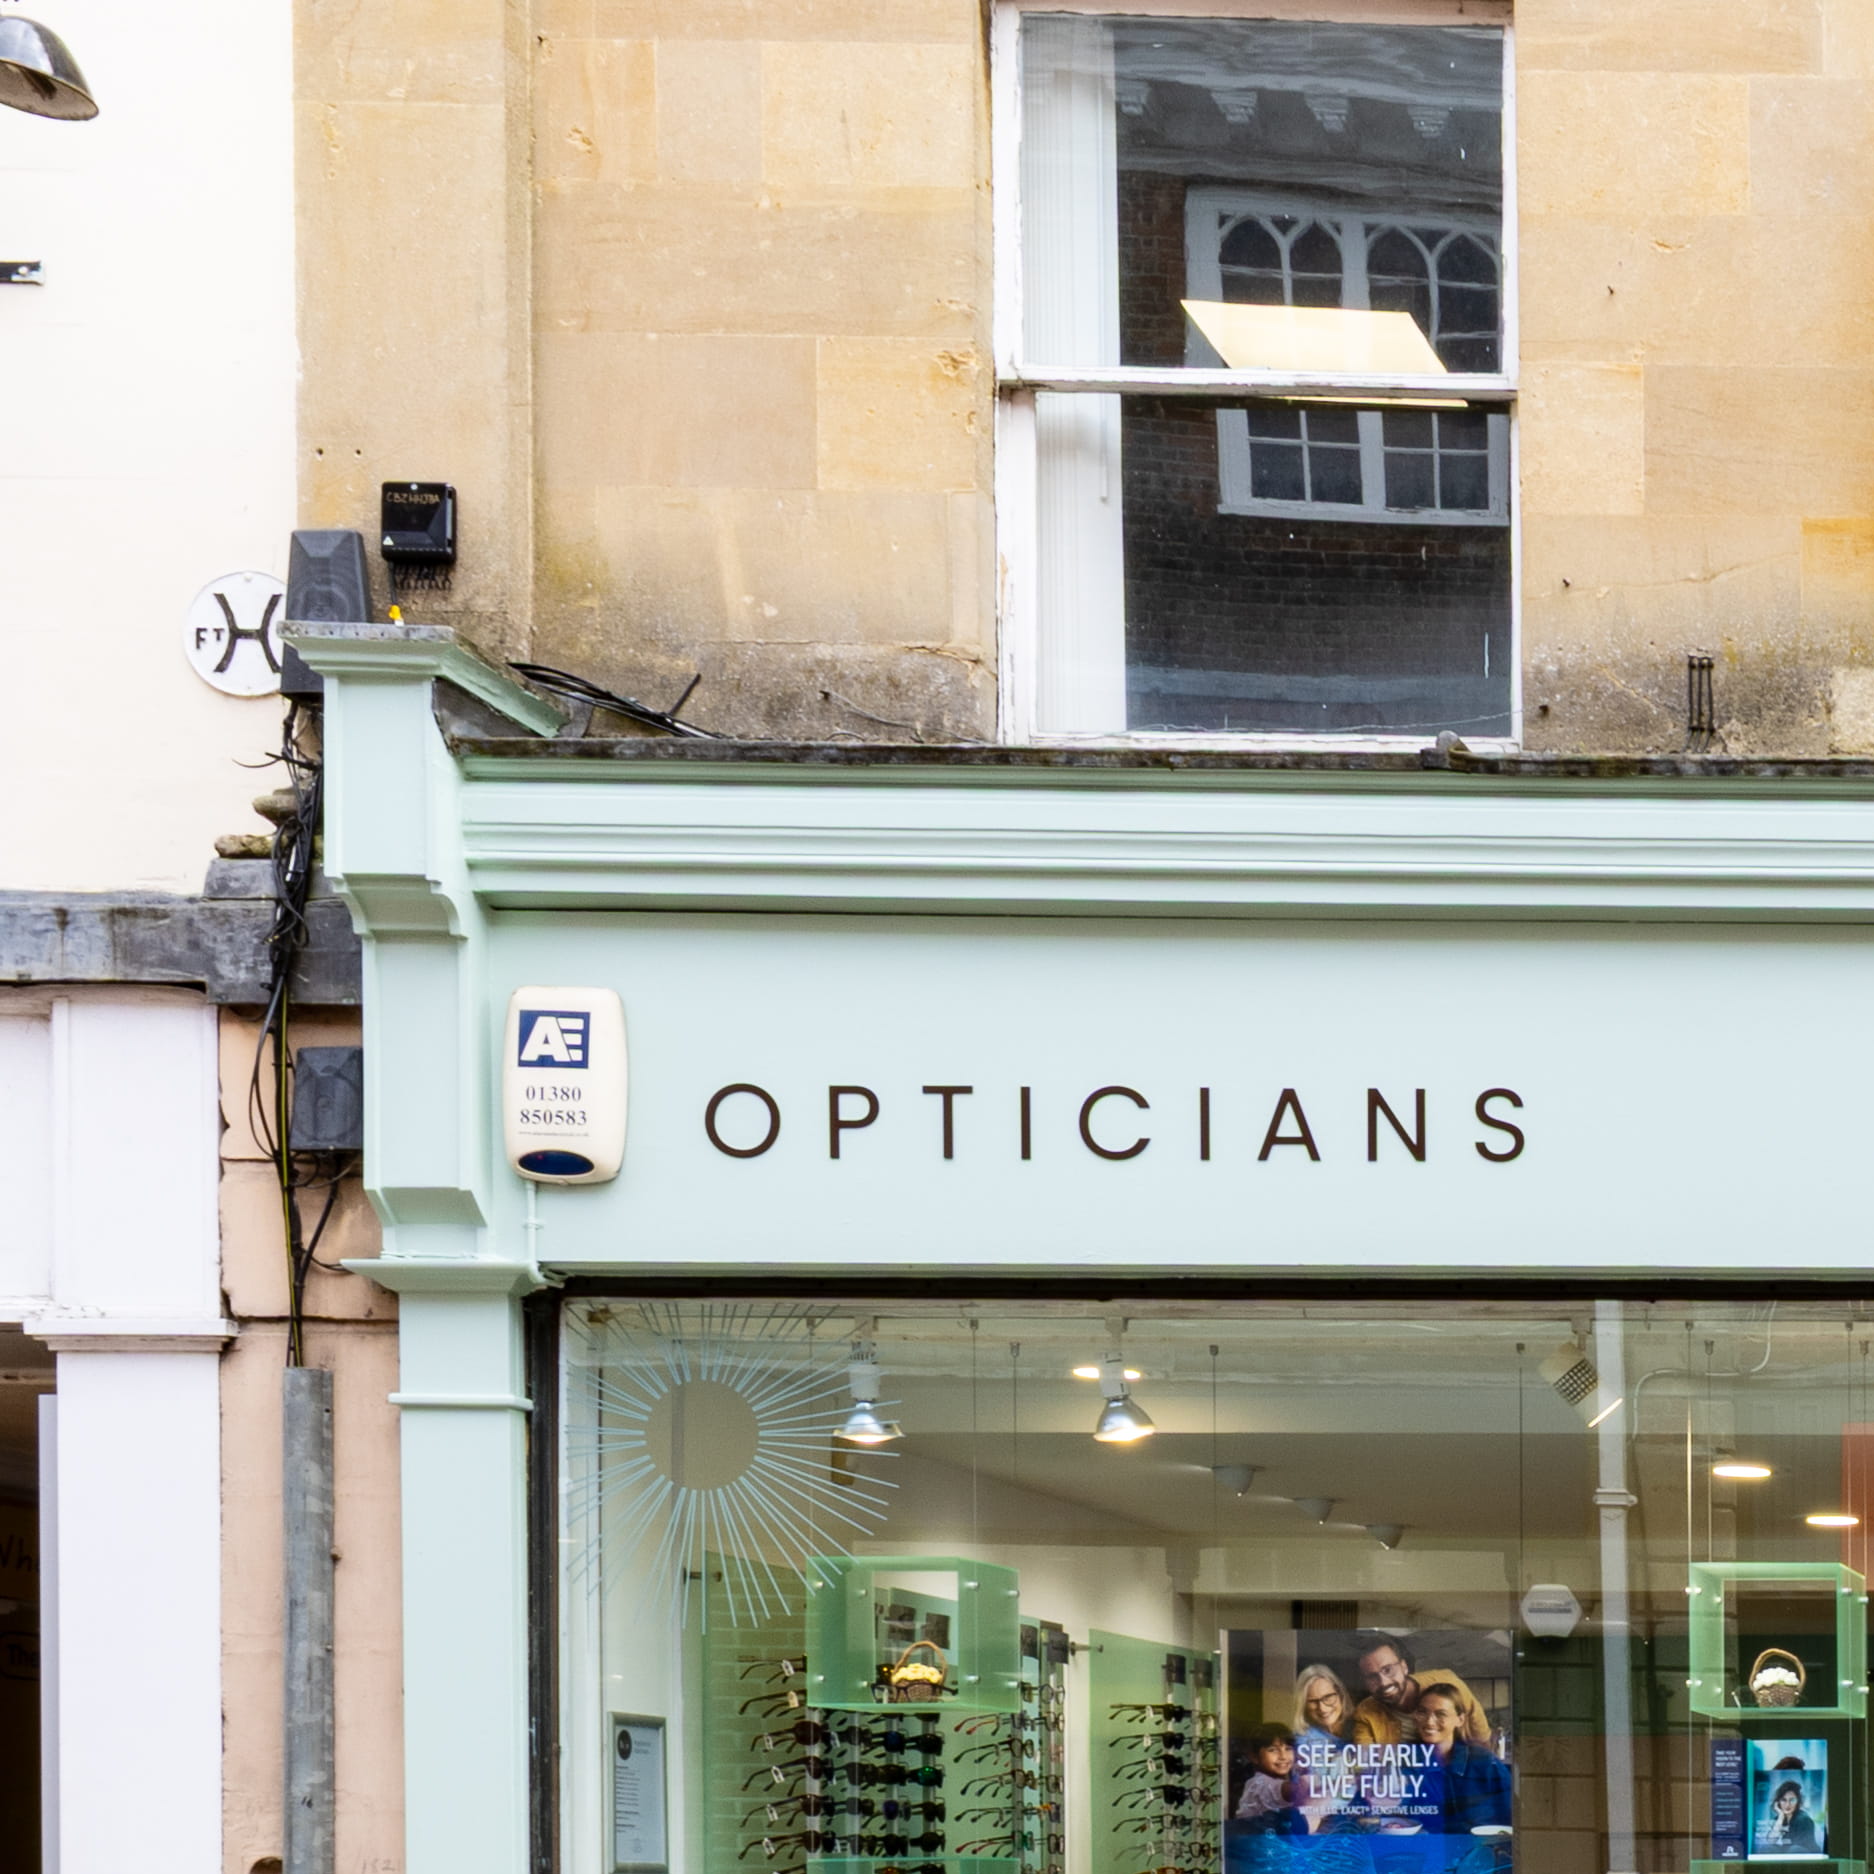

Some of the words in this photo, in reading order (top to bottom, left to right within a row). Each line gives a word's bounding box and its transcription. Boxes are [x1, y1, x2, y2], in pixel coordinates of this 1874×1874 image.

[526, 1085, 581, 1102] 01380
[520, 1109, 587, 1126] 850583
[704, 1082, 1526, 1163] OPTICIANS
[1297, 1744, 1336, 1767] SEE
[1343, 1744, 1438, 1767] CLEARLY.
[1309, 1775, 1354, 1798] LIVE
[1361, 1775, 1427, 1798] FULLY.
